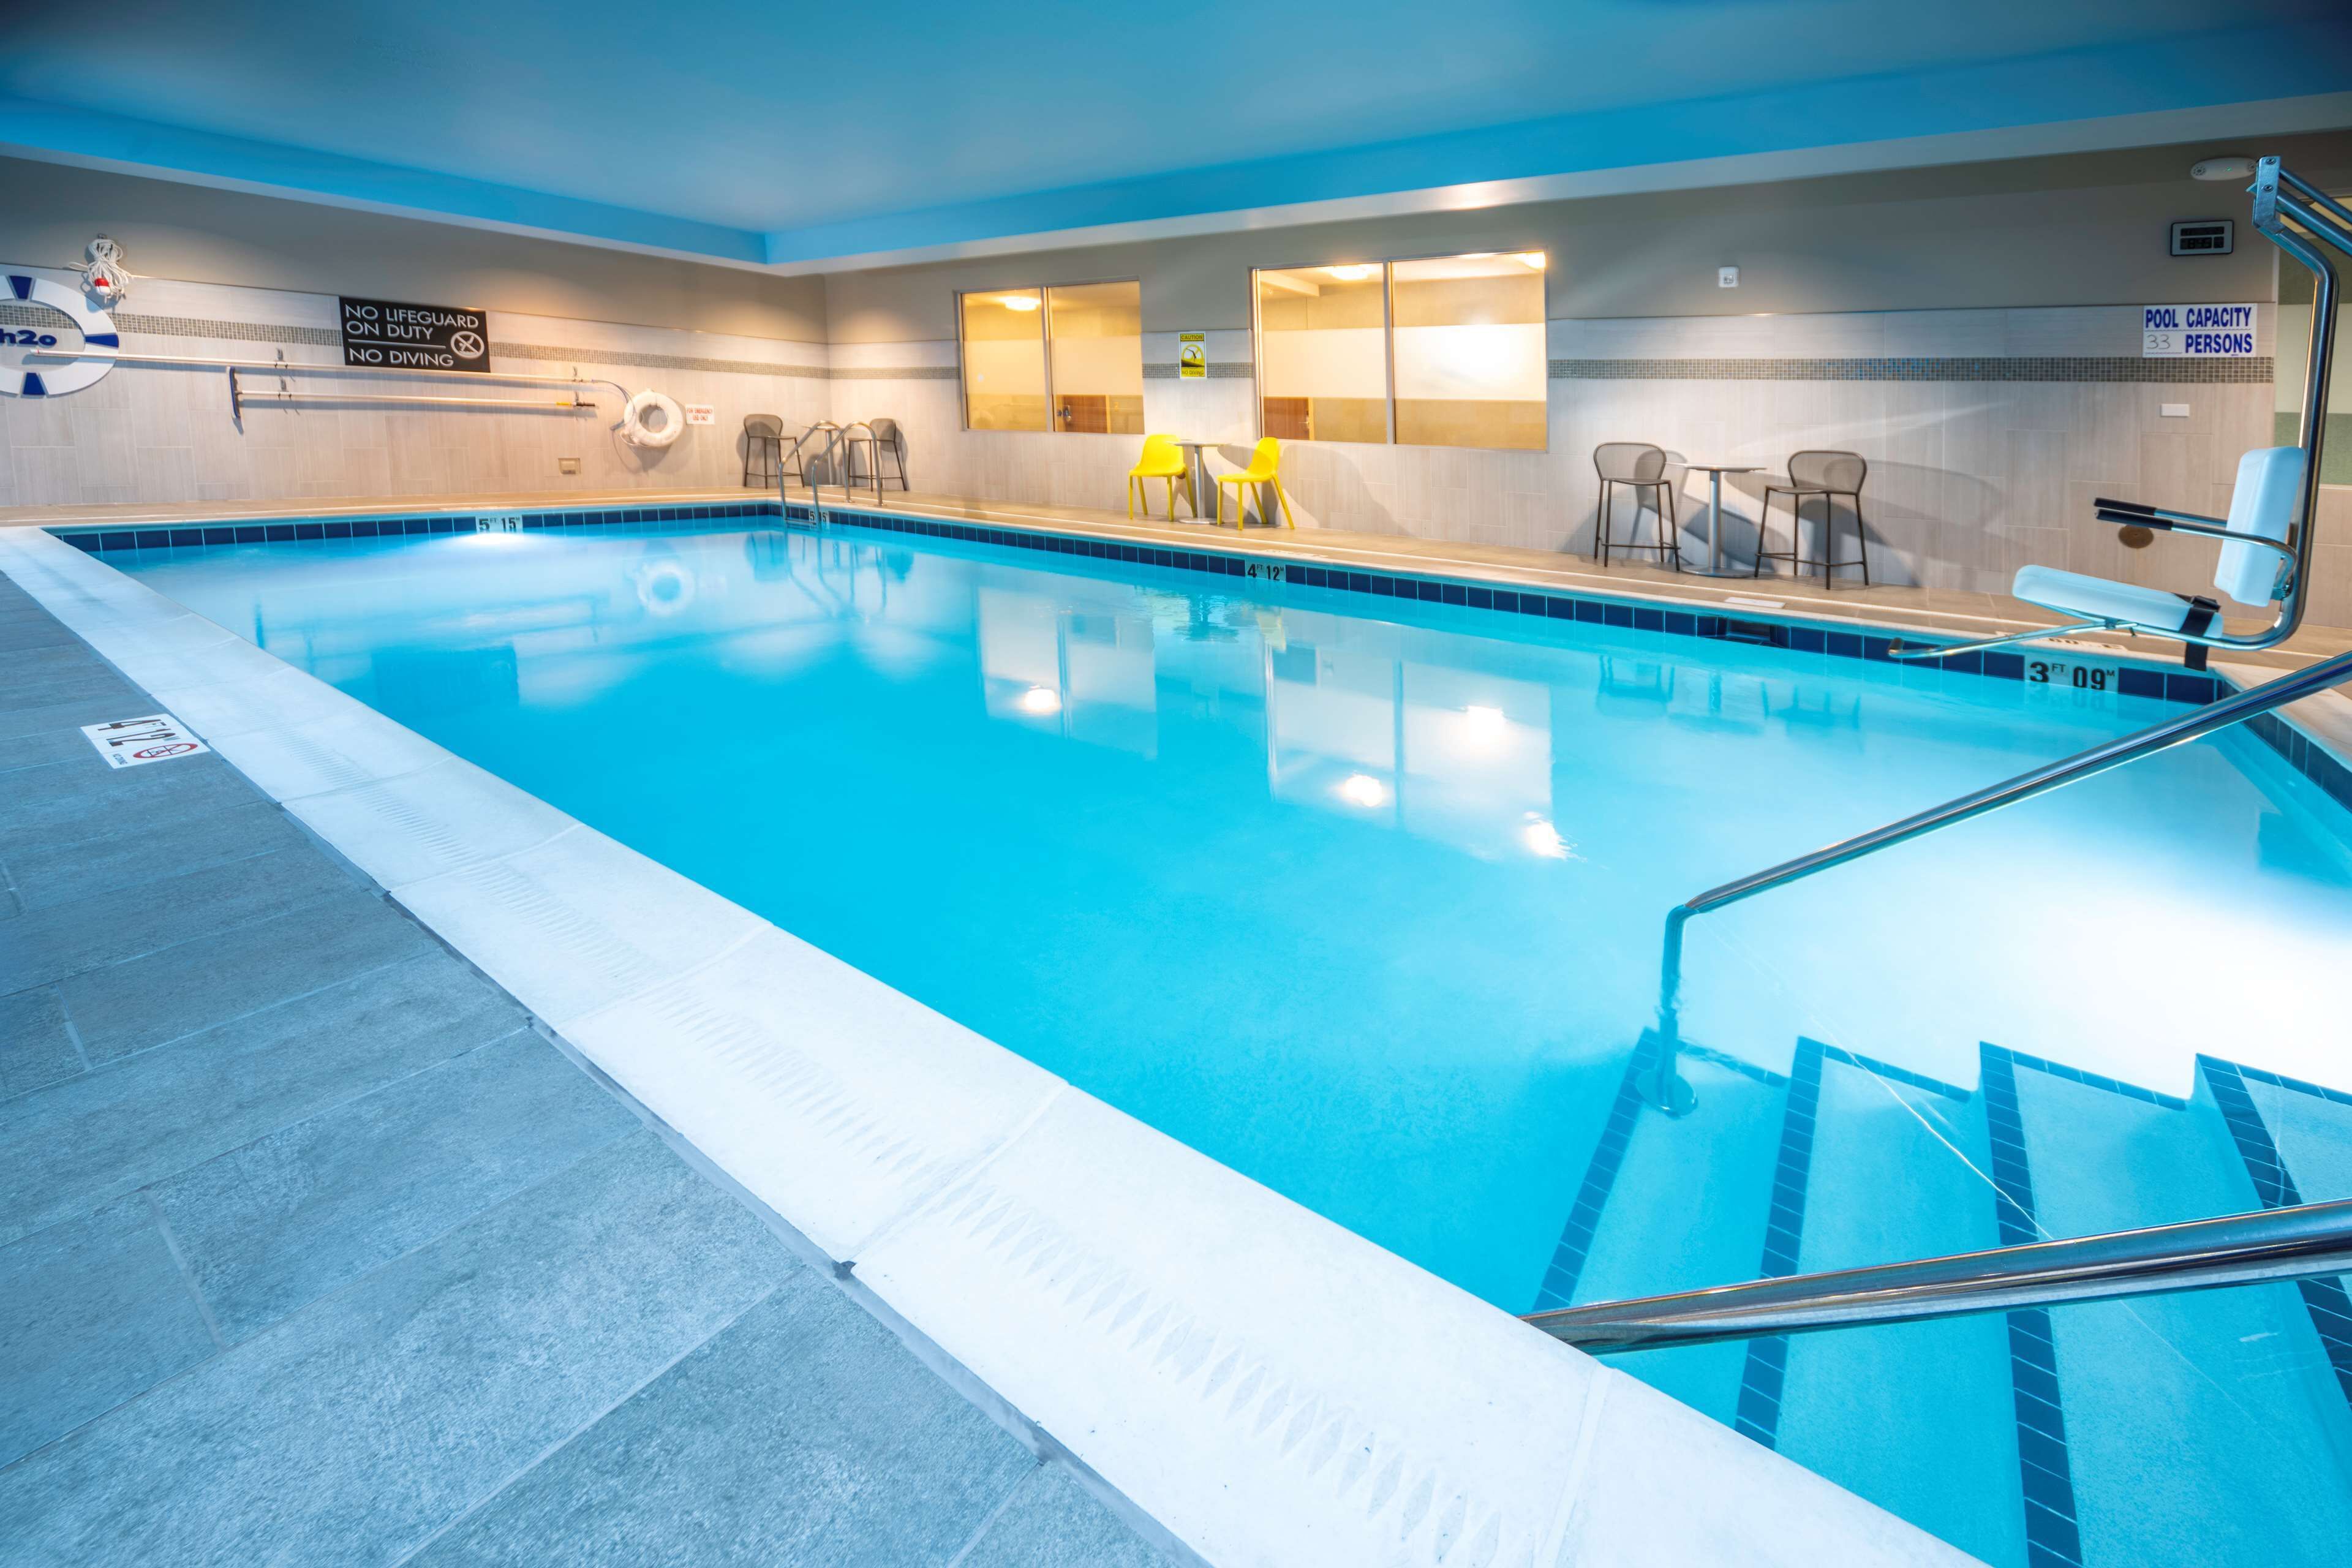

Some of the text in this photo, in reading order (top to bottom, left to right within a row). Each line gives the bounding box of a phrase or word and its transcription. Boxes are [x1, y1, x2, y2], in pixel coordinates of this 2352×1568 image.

[345, 304, 479, 329] NO LIFEGUARD
[2146, 307, 2252, 328] POOL CAPACITY
[347, 321, 434, 339] ON DUTY
[2147, 334, 2171, 350] 33
[2185, 334, 2253, 353] PERSONS
[349, 348, 454, 367] NO DIVING
